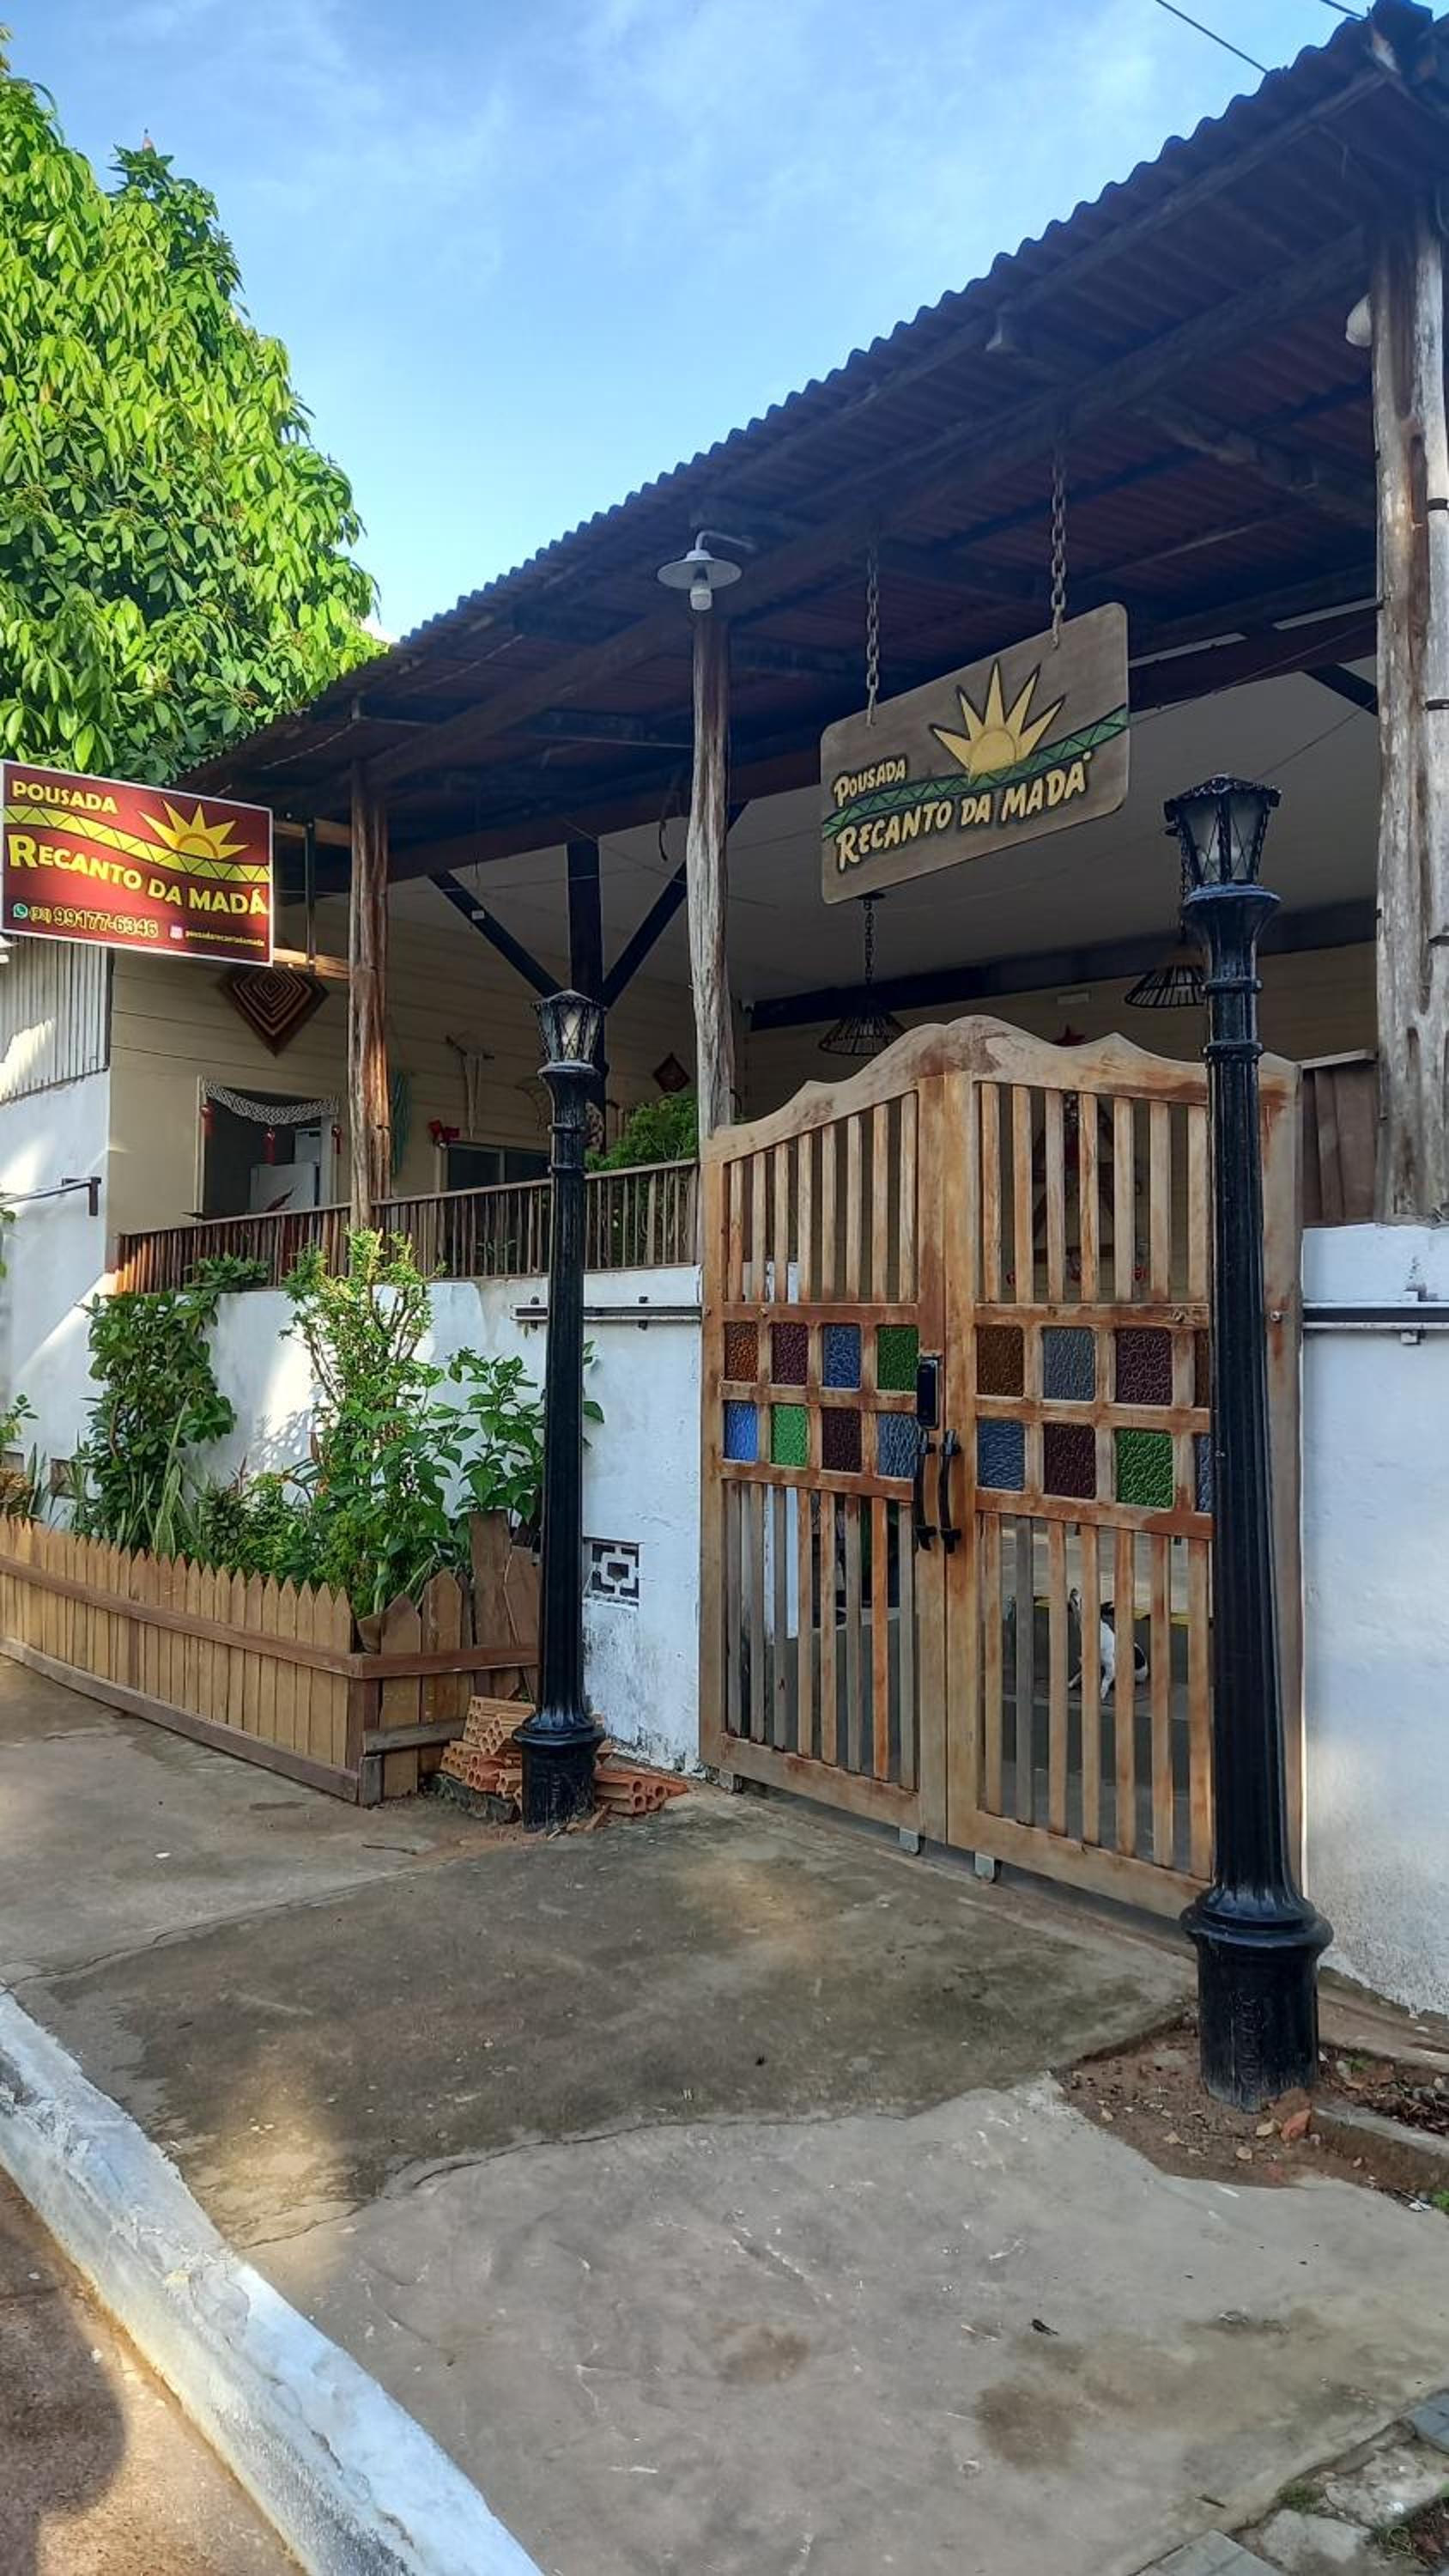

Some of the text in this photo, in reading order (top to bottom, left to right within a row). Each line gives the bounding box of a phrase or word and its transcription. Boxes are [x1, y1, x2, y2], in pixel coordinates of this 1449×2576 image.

[12, 780, 118, 814] POUSADA
[833, 756, 906, 807] POUSADA
[835, 800, 953, 872] RECANTO
[961, 793, 992, 826] DA
[7, 834, 269, 914] RECANTO DA MADÁ
[53, 906, 159, 939] 99177-6346
